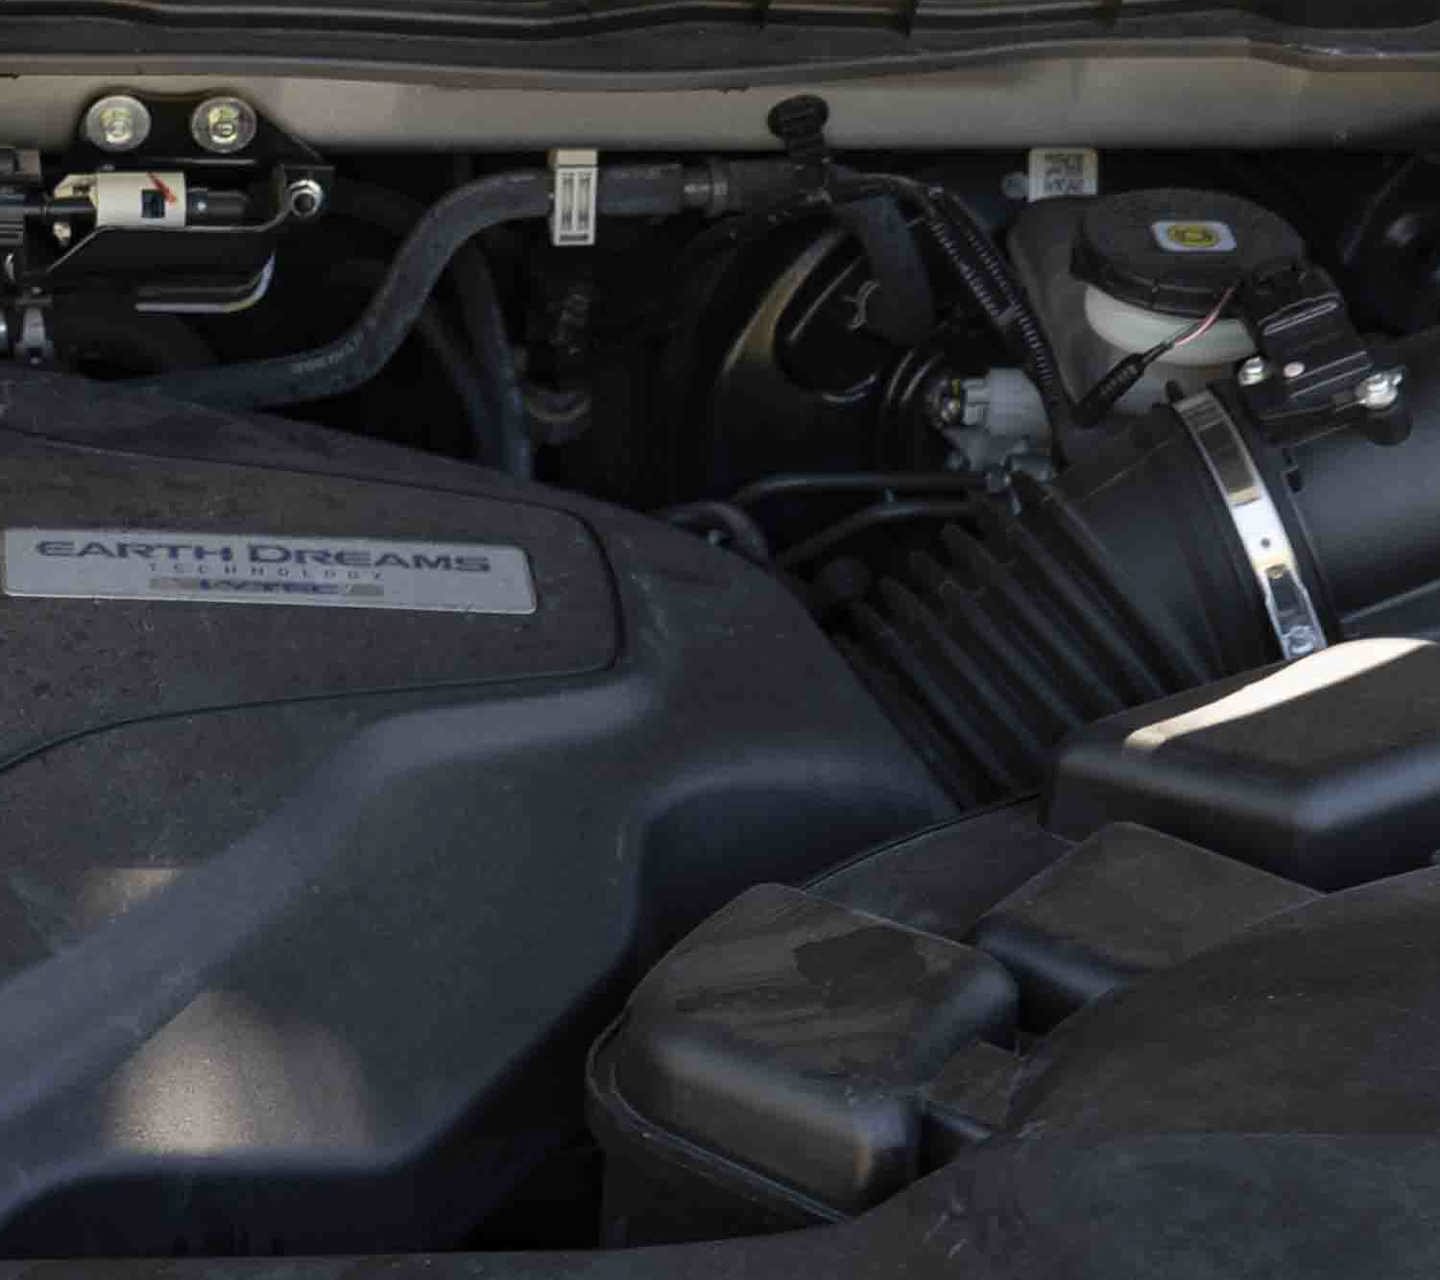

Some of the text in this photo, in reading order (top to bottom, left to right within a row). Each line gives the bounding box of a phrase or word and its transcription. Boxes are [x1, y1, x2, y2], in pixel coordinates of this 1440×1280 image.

[34, 539, 492, 572] EARTH DREAMS
[148, 562, 384, 581] TECHNOLOGY
